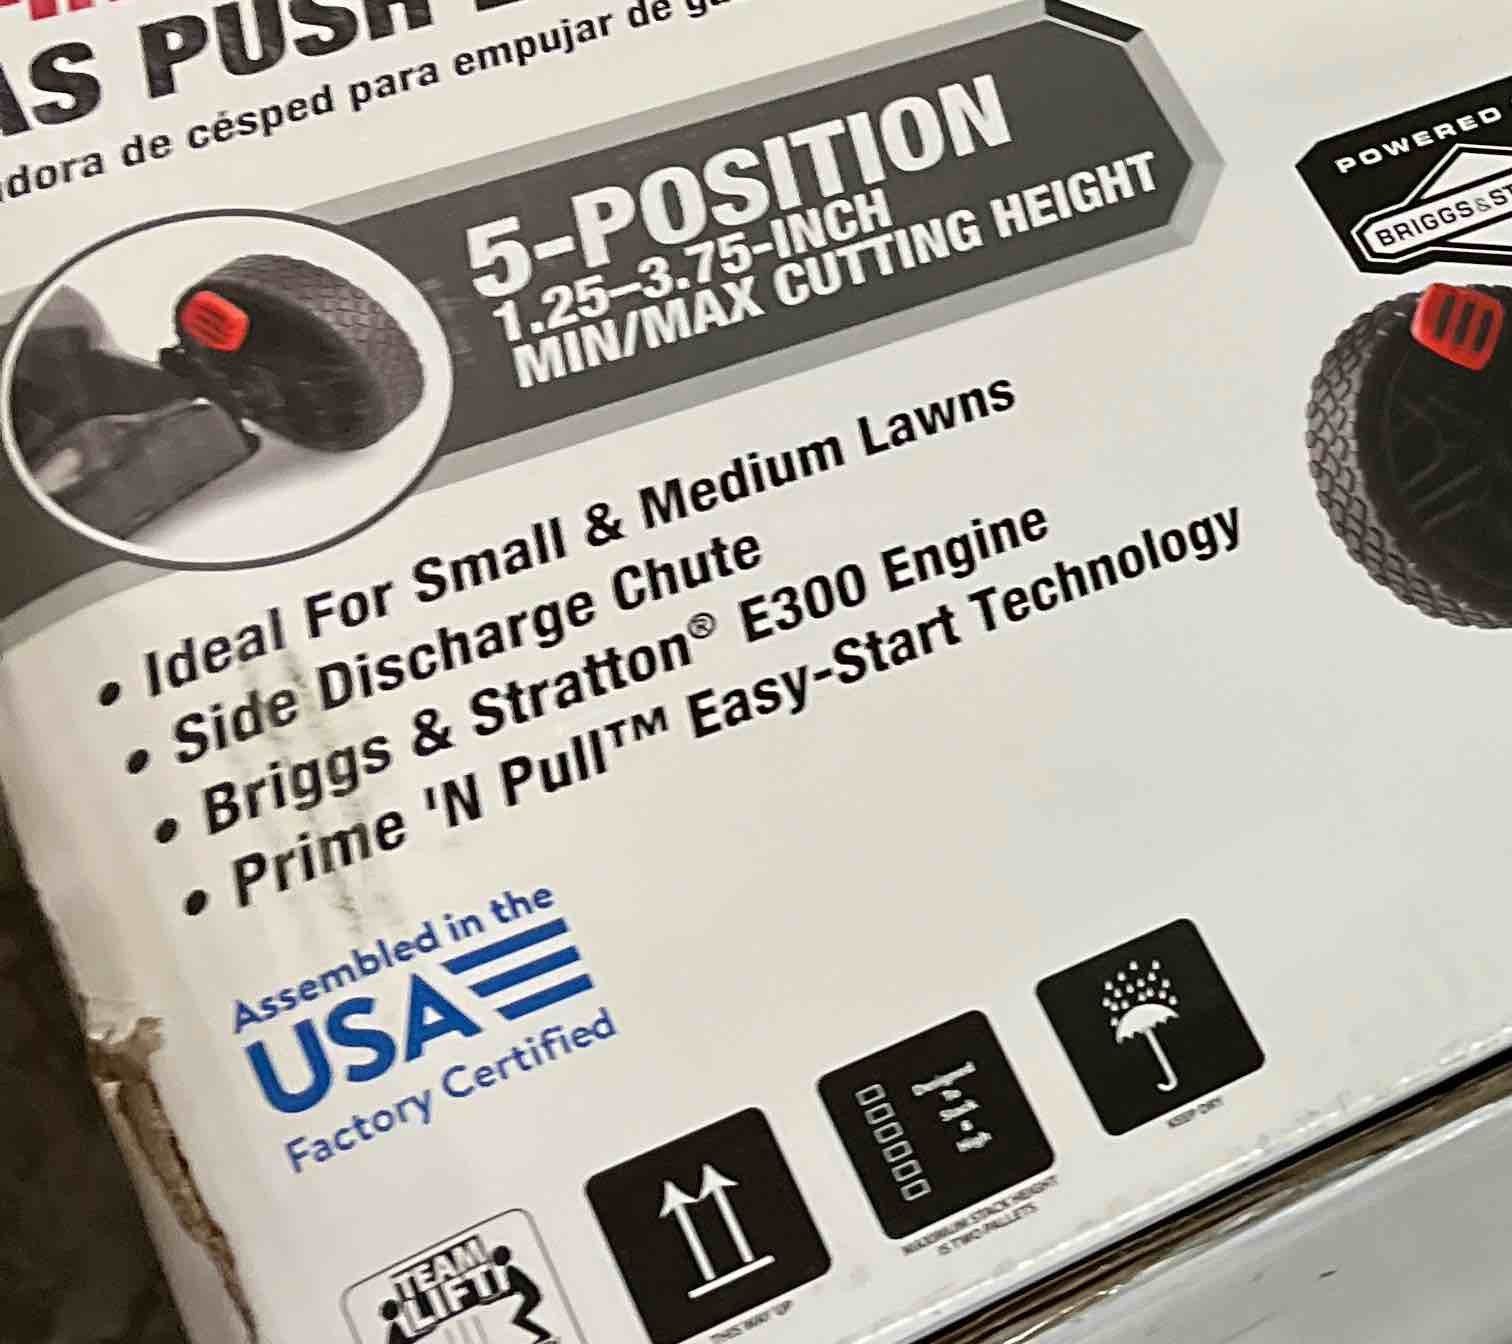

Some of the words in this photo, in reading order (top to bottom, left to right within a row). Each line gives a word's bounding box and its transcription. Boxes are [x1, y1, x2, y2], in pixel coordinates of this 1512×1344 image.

[0, 152, 105, 202] dora
[121, 133, 173, 168] de
[186, 83, 336, 150] césped
[349, 60, 440, 111] para
[454, 9, 613, 77] empujar
[464, 72, 1013, 299] 5-POSITION
[1334, 106, 1503, 175] POWERED
[511, 274, 766, 390] MIN/MAX
[772, 208, 985, 307] CUTTING
[991, 150, 1159, 239] HEIGHT
[143, 607, 286, 698] Ideal
[303, 579, 394, 640] For
[411, 517, 567, 604] Small
[583, 502, 625, 548] &
[637, 435, 846, 530] Medium
[856, 377, 1017, 456] Lawns
[172, 685, 299, 765] Side
[315, 589, 596, 713] Discharge
[610, 530, 764, 612] Chute
[200, 733, 393, 836] Briggs
[410, 707, 454, 757] &
[737, 562, 868, 643] E300
[879, 505, 1051, 593] Engine
[231, 809, 407, 909] Prime
[685, 601, 962, 739] Easy-Start
[966, 504, 1242, 633] Technology
[232, 919, 441, 1035] Assembled
[442, 911, 487, 944] in
[489, 886, 555, 925] the
[243, 971, 484, 1115] USA
[284, 1088, 435, 1174] Factory
[440, 1006, 619, 1100] Certified
[393, 1234, 492, 1300] TEAM
